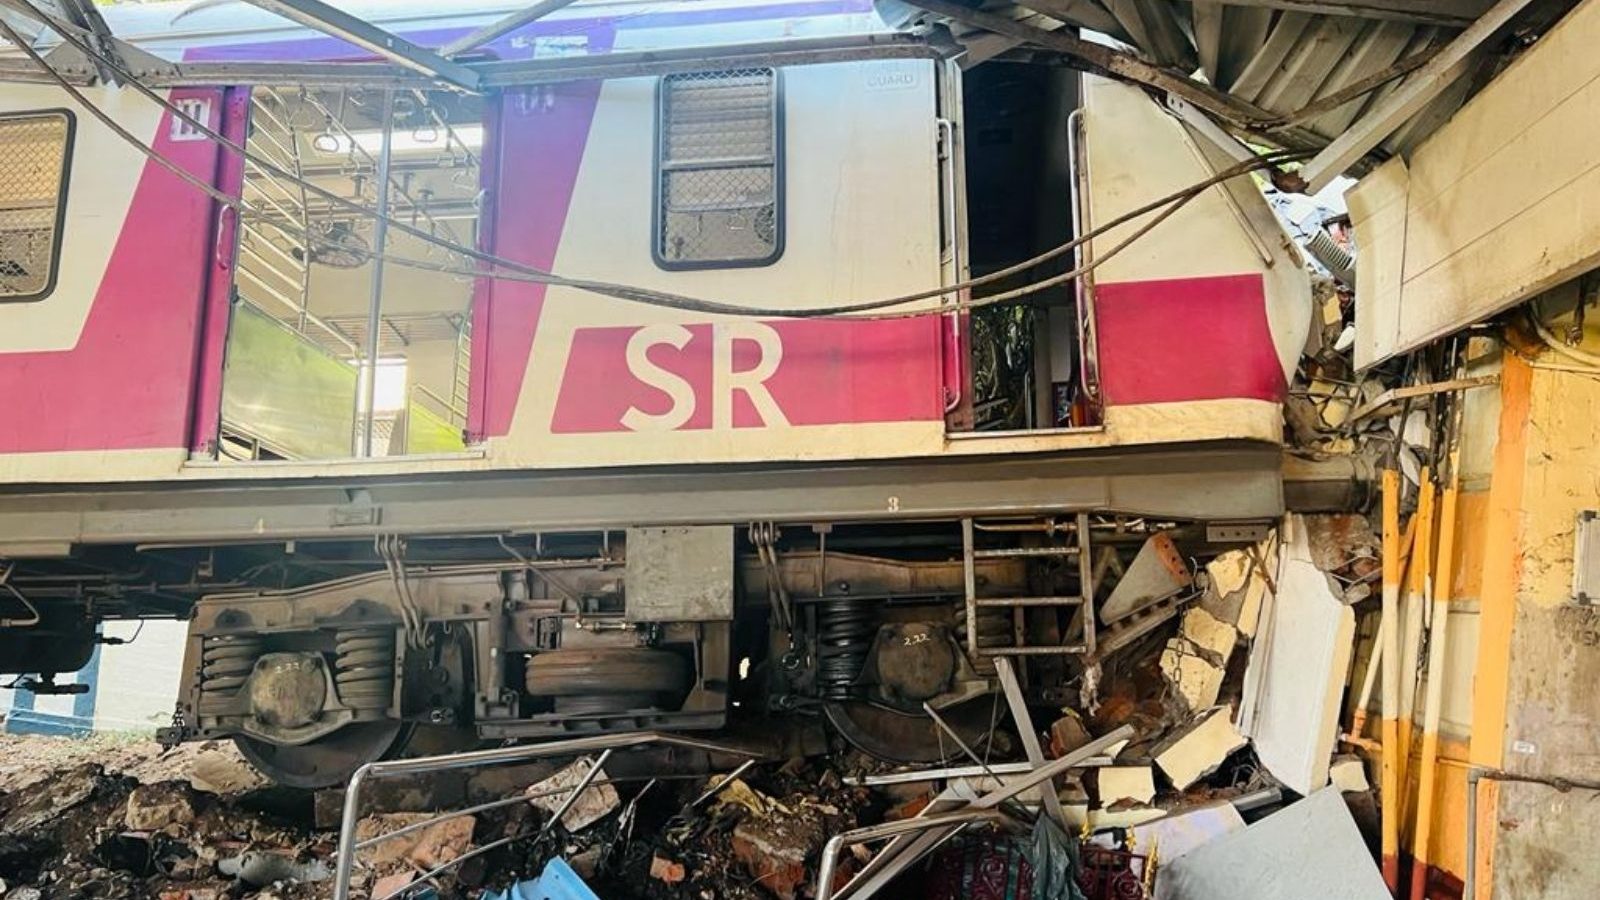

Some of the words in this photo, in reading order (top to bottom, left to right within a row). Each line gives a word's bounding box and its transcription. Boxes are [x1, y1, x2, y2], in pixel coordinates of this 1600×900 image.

[867, 72, 913, 87] GUARD
[619, 322, 792, 430] SR
[888, 496, 899, 512] 3
